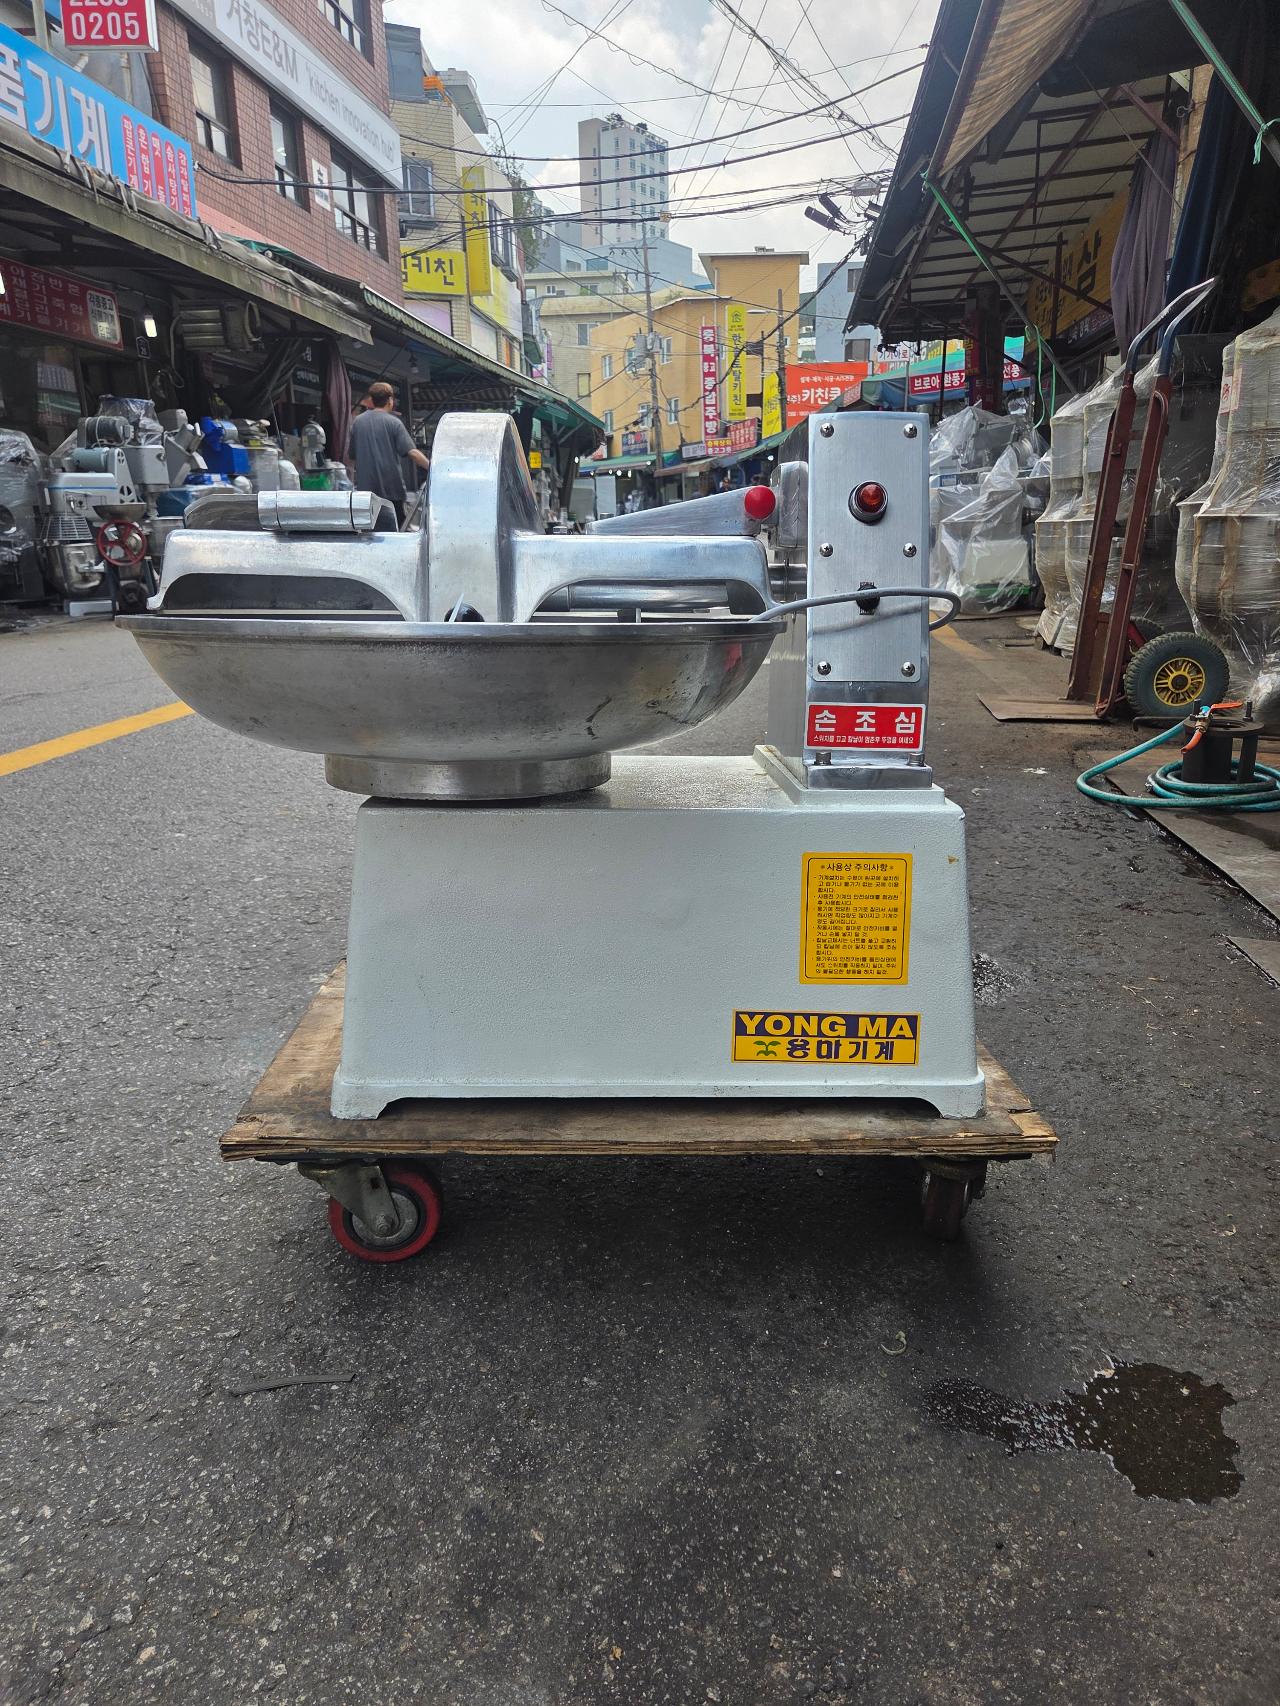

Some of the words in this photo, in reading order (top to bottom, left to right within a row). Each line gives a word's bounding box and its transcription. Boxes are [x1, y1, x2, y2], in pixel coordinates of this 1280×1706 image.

[71, 12, 140, 40] 0205
[739, 1014, 847, 1036] YONG
[858, 1017, 913, 1038] MA
